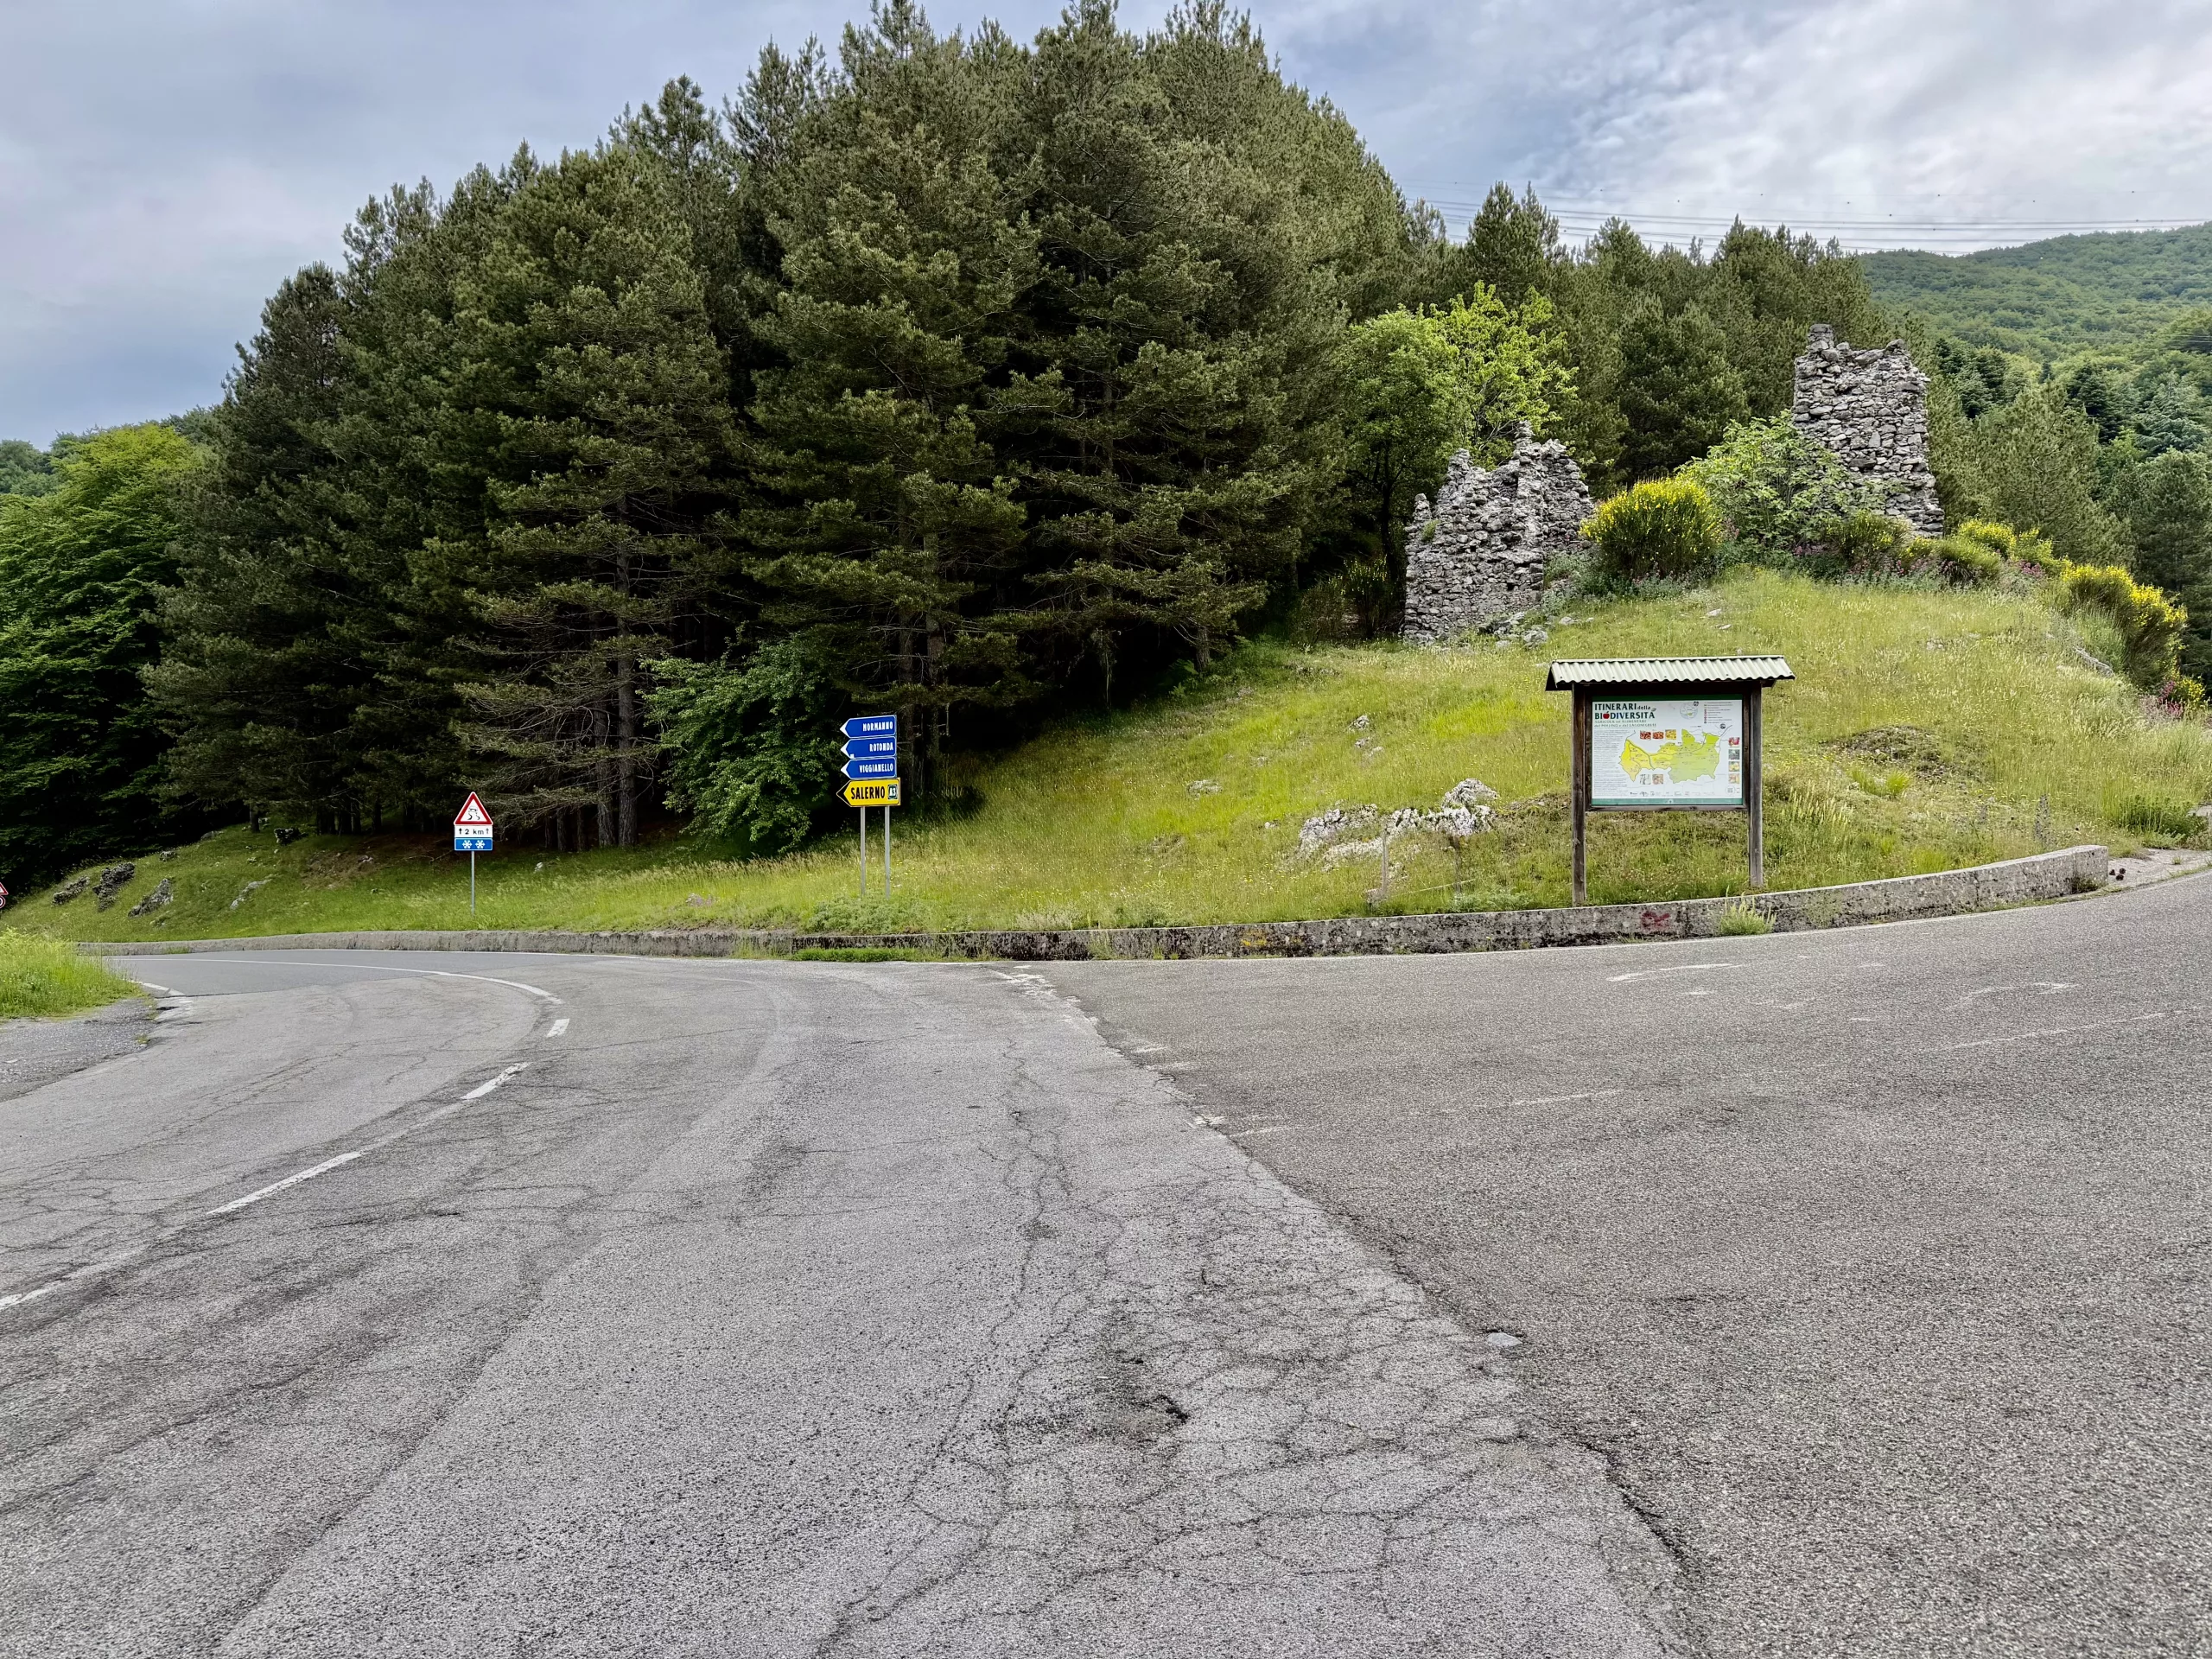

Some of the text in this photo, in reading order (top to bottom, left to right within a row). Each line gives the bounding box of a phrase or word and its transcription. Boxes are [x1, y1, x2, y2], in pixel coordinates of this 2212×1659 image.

[863, 721, 893, 731] MORMANNO
[869, 742, 893, 752] ROTONDA
[859, 763, 893, 773] VIGGIANELLO
[850, 786, 896, 800] SALERNO A3
